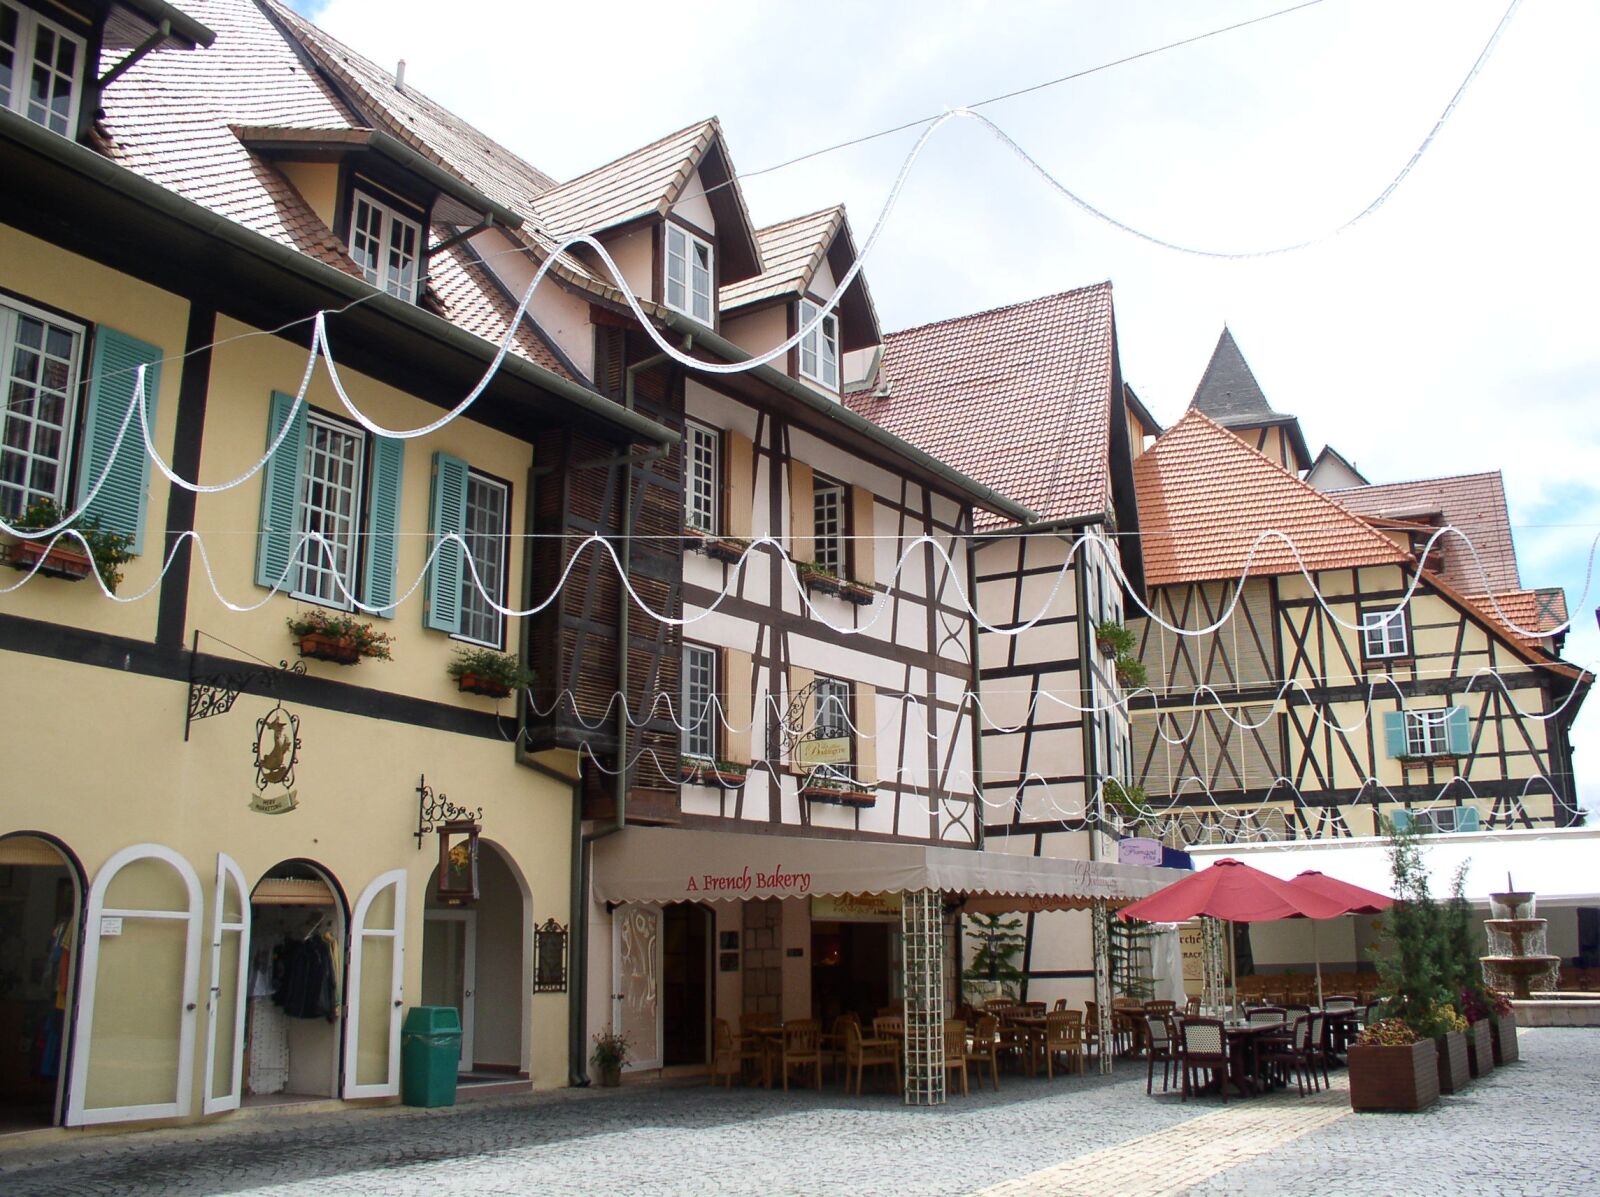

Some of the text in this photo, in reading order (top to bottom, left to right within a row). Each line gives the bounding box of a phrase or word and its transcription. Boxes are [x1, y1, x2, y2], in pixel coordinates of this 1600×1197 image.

[686, 864, 811, 892] A French Bakery
[1180, 932, 1201, 944] rché
